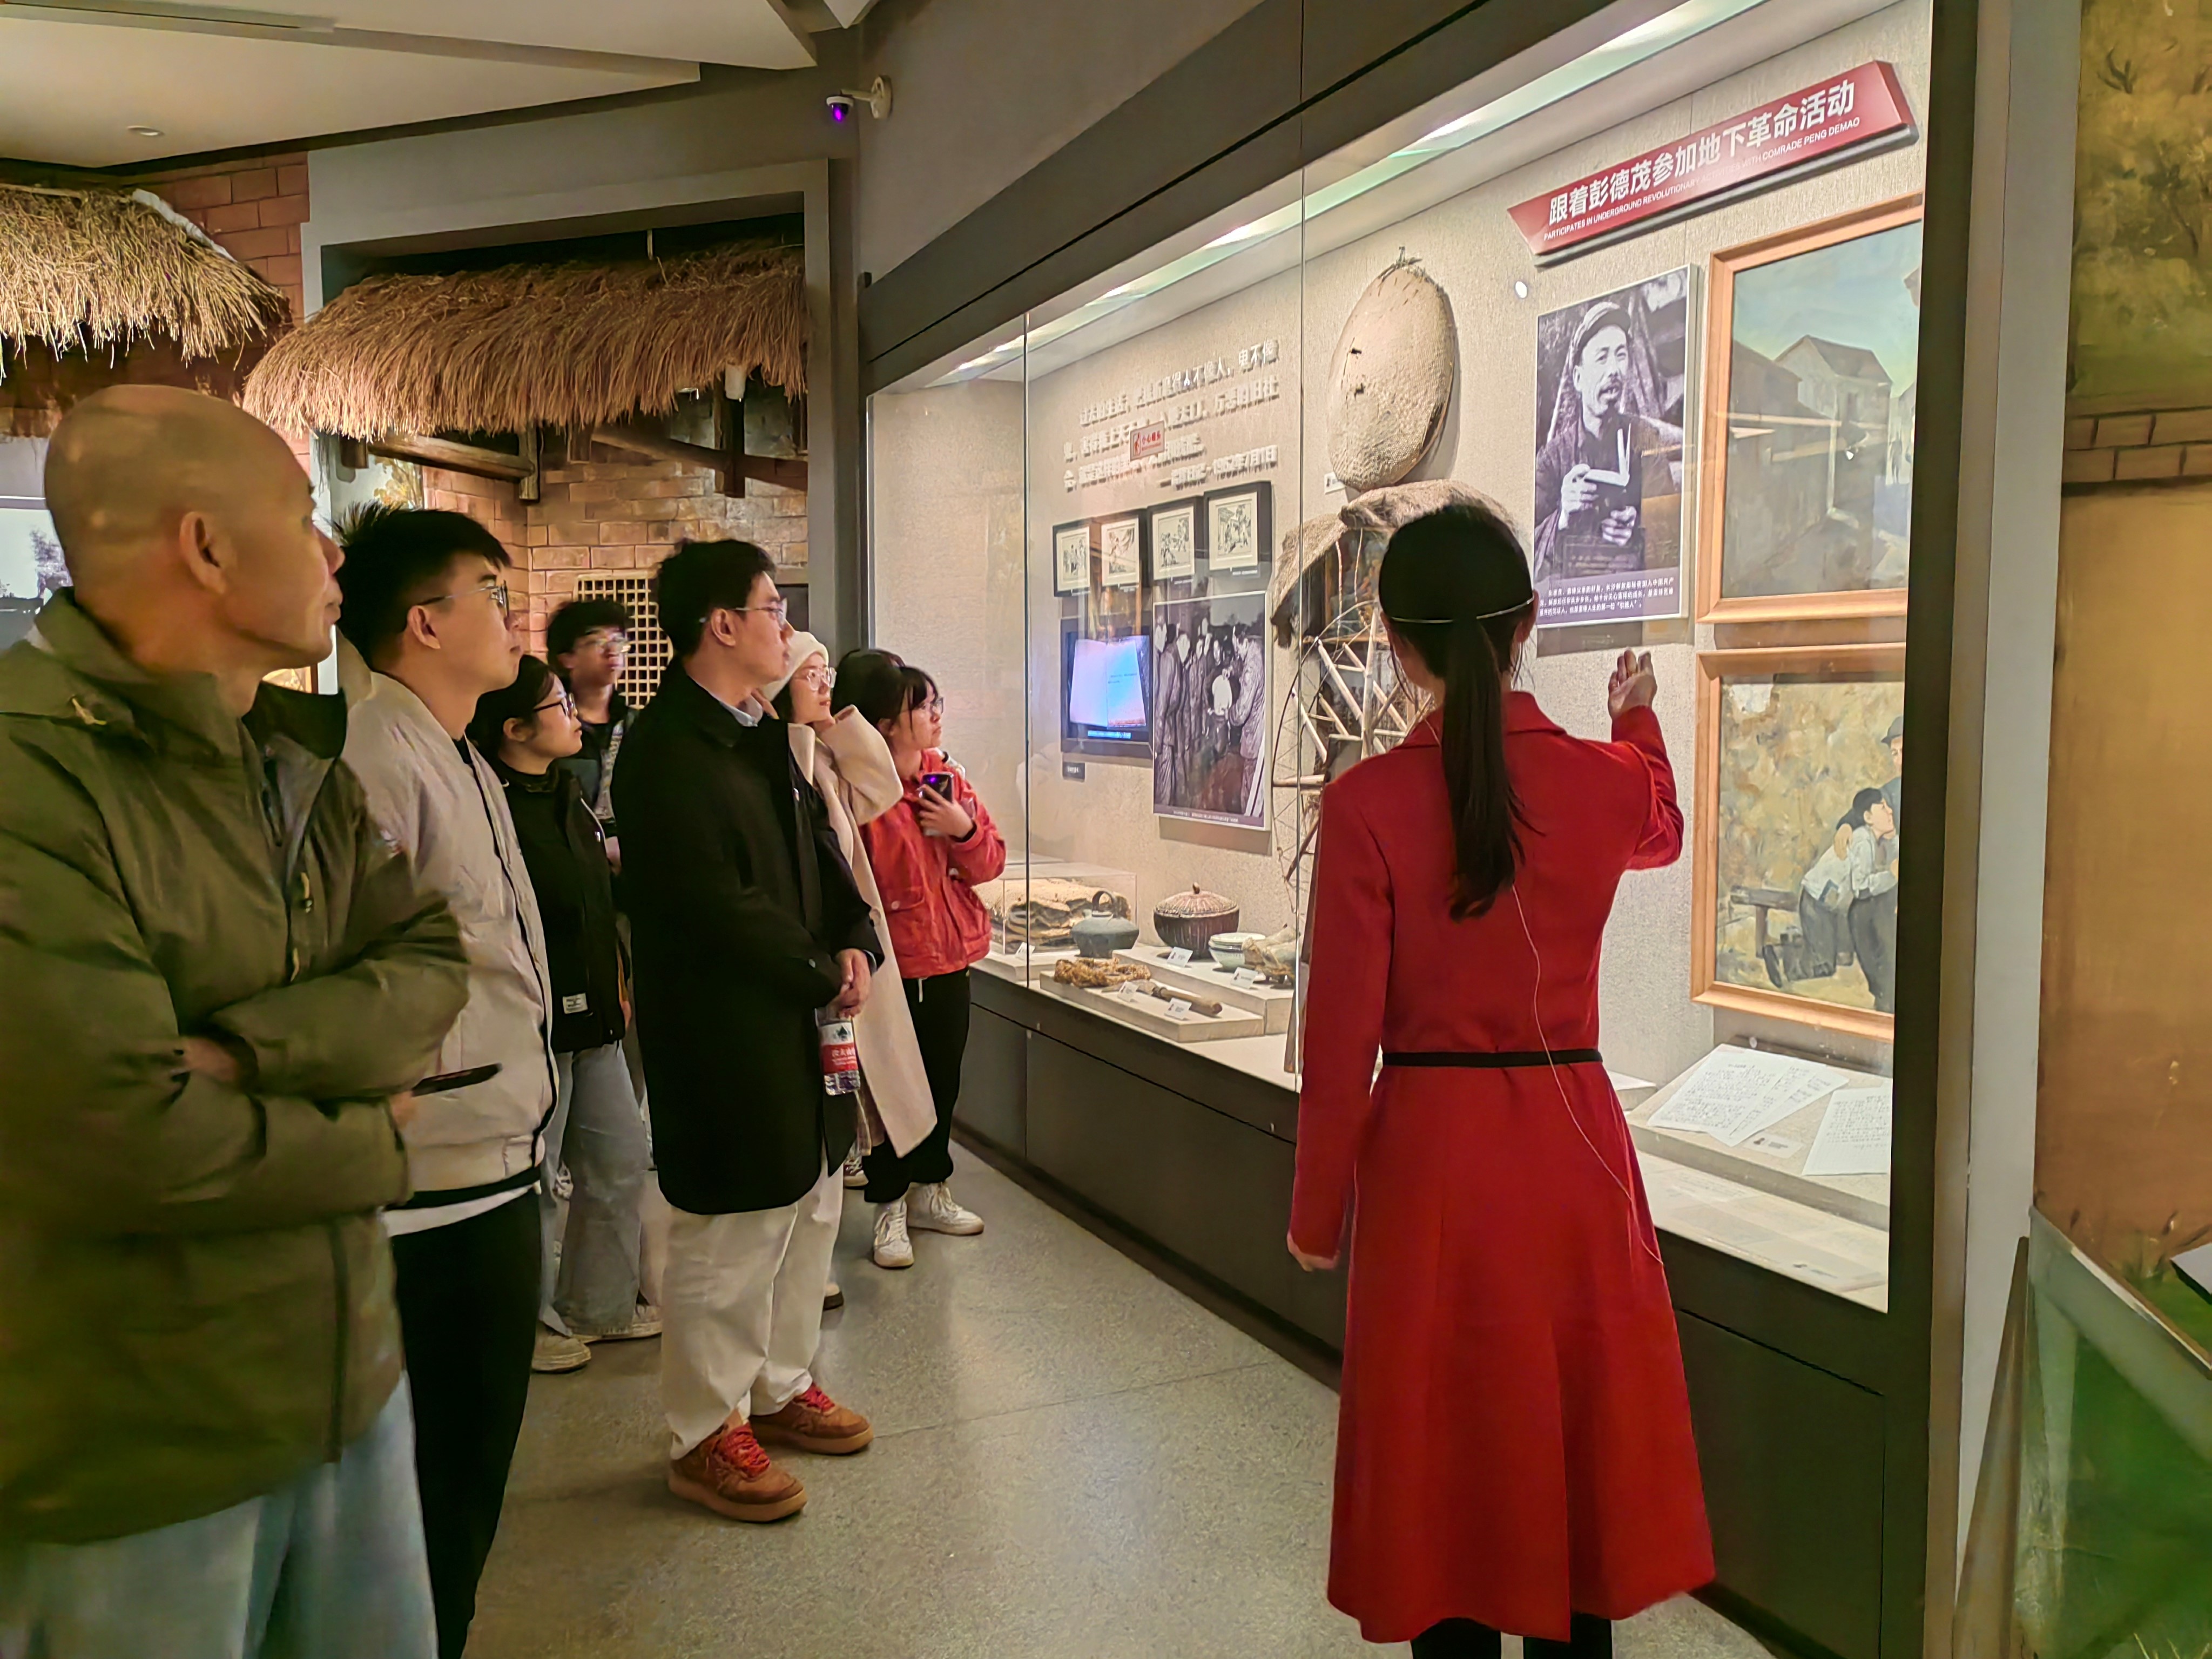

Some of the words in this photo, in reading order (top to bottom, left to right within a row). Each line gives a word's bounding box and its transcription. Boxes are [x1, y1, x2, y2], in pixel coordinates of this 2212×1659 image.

[1549, 79, 1854, 226] 跟着彭德茂参加地下革命活动
[1586, 216, 1593, 227] IN
[1593, 198, 1642, 224] UNDERGROUND
[1643, 177, 1700, 205] REVOLUTIONARY
[1762, 138, 1803, 160] COMRADE
[1804, 130, 1827, 146] PENG
[1828, 117, 1860, 136] DEMAO
